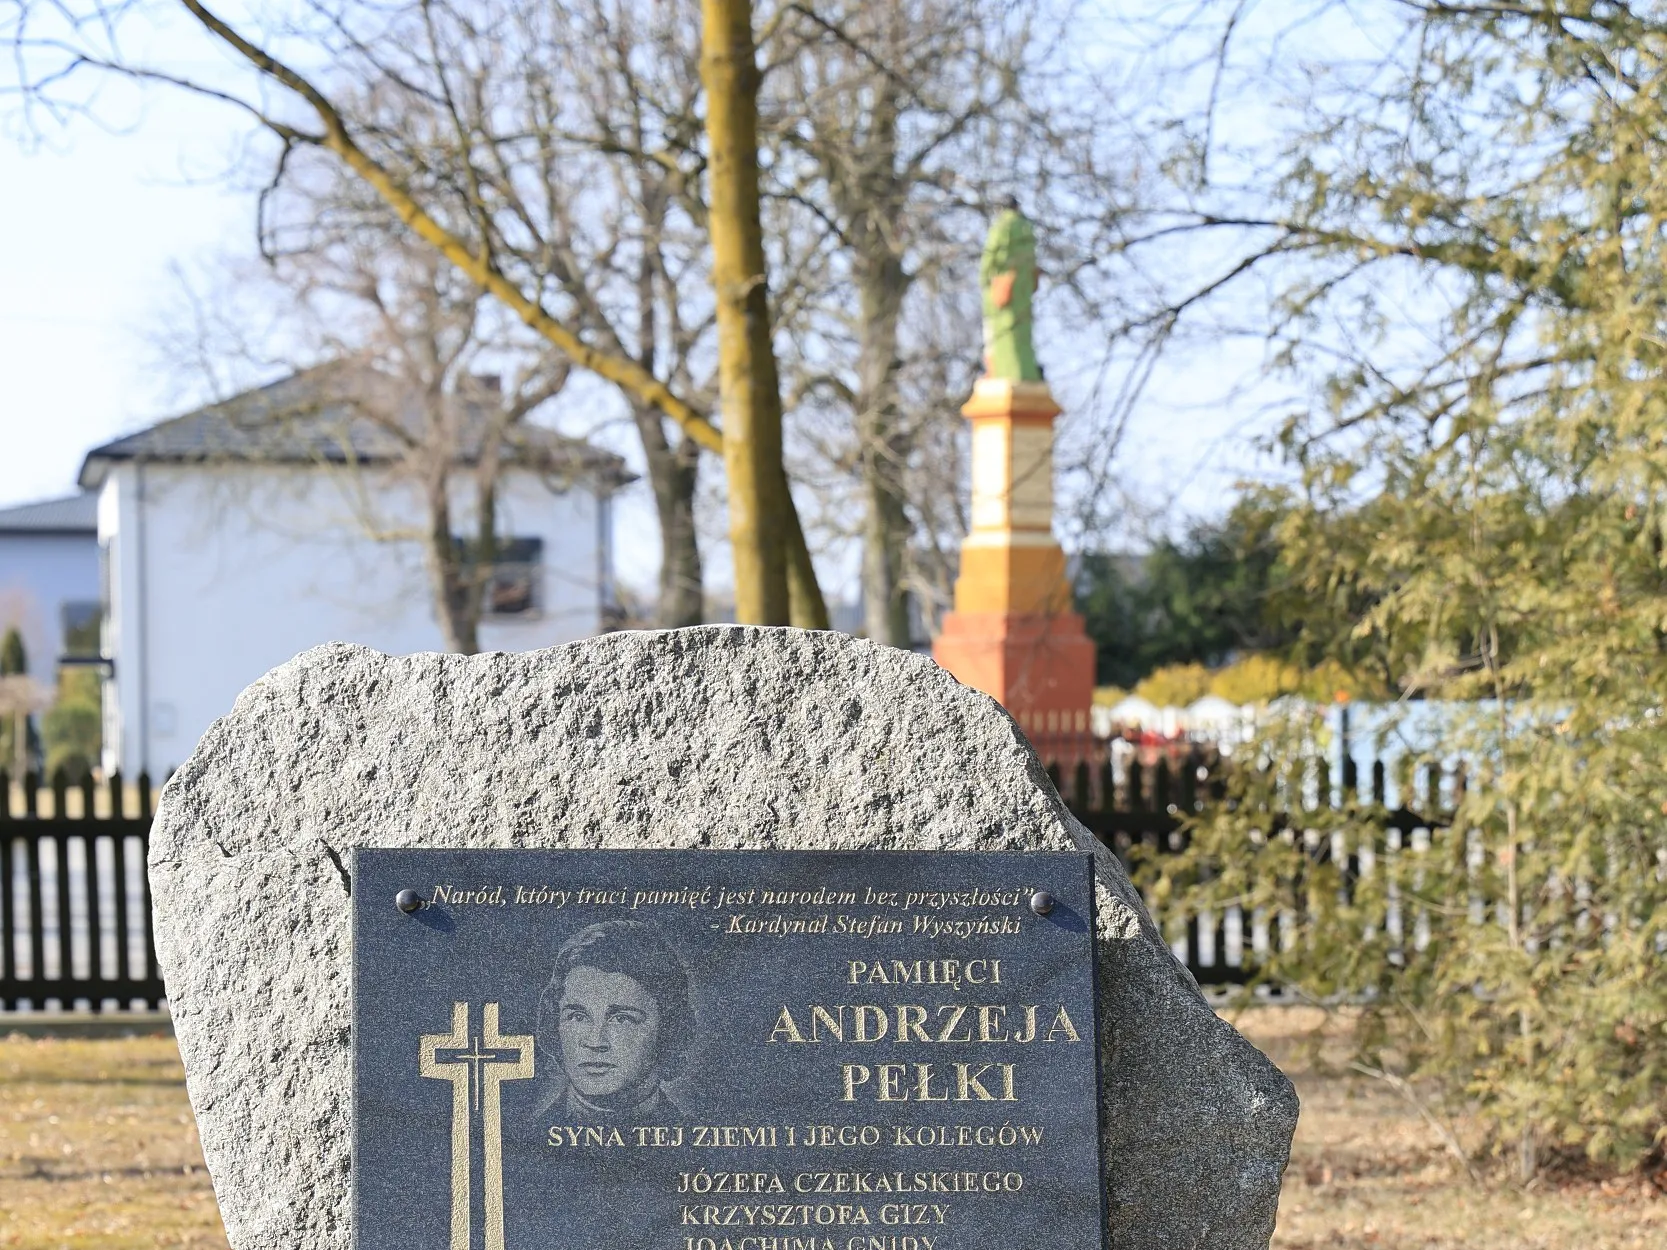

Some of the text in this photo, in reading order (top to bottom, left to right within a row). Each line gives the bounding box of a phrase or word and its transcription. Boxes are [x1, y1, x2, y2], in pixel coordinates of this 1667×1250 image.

[515, 885, 572, 910] który
[576, 886, 627, 905] traci
[629, 885, 712, 910] pamięć
[713, 886, 756, 910] jest
[761, 886, 856, 906] narodem
[865, 886, 898, 907] bez
[725, 914, 828, 938] Kardynał
[832, 914, 903, 938] Stefan
[912, 915, 1021, 939] Wyszyński
[847, 959, 1002, 990] PAMIĘCI
[766, 1004, 1082, 1043] ANDRZEJA
[839, 1063, 1019, 1101] PEŁKI
[548, 1121, 1046, 1147] SYNA TEJ ZIEMI I JEGO KOLEGÓW
[678, 1167, 1024, 1194] JÓZEFA CZEKALSKIEGO
[680, 1203, 950, 1226] KRZYSZTOFA GIZY
